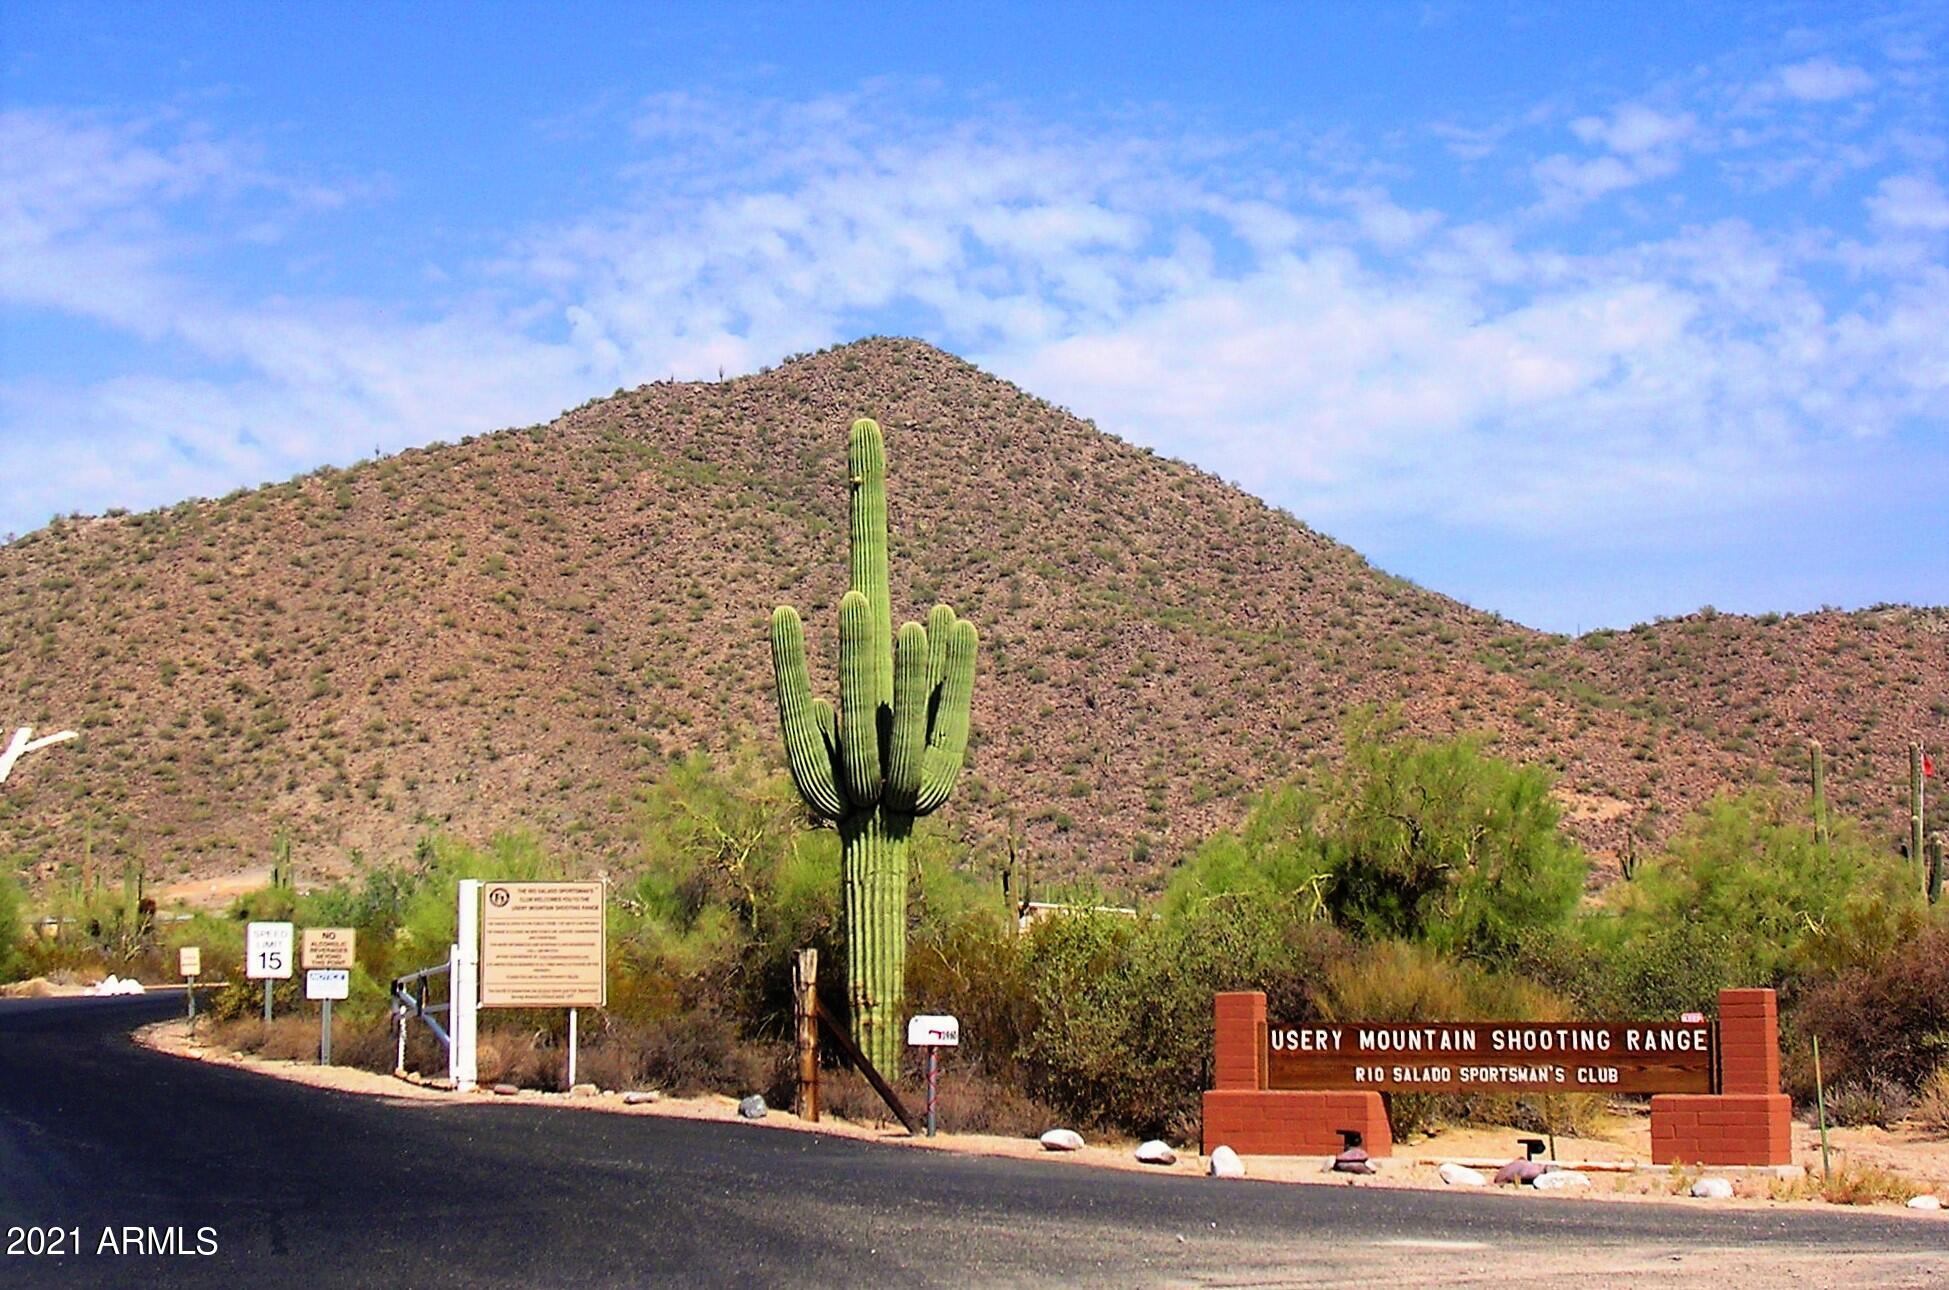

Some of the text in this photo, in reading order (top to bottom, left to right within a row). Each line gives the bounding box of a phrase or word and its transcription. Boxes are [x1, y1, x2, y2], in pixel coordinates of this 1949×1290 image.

[254, 930, 288, 938] SPEED
[322, 932, 336, 940] NO
[257, 941, 283, 949] LIMIT
[258, 952, 282, 970] 15
[1271, 1029, 1708, 1051] USERY MOUNTAIN SHOOTING RANGE
[1355, 1065, 1619, 1083] RIO SALADO SPORTSMAN'S CLUB
